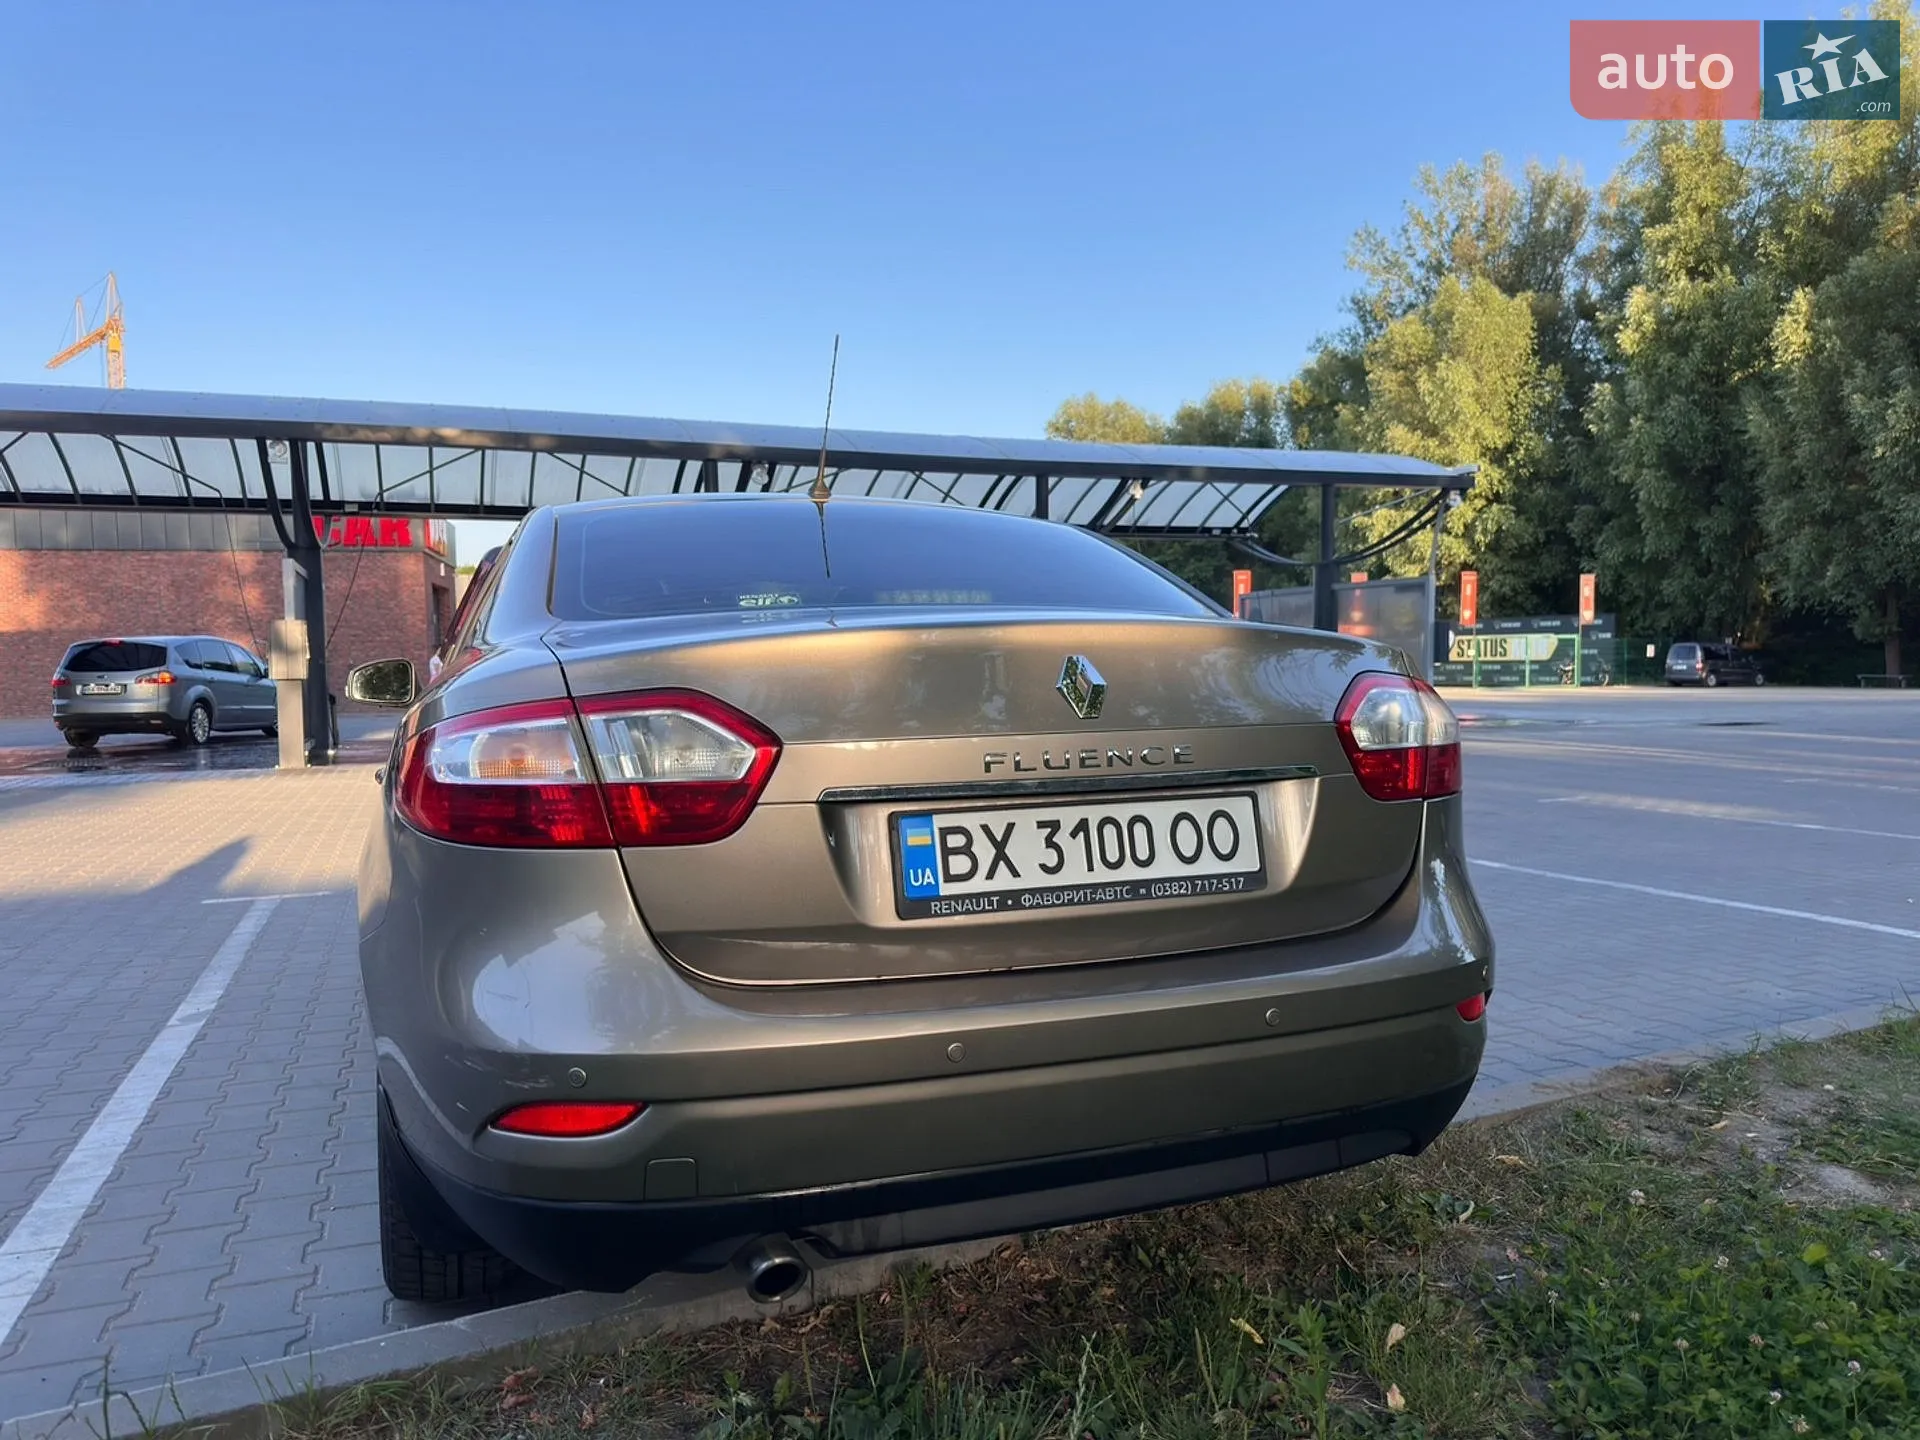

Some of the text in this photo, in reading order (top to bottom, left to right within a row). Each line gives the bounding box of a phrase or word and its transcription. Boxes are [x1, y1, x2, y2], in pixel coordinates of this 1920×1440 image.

[983, 744, 1195, 773] FLUENCE
[938, 809, 1240, 883] BX 3100 OO
[910, 869, 935, 887] UA
[1151, 877, 1245, 898] (0382) 717-517
[931, 896, 1000, 915] RENAULT
